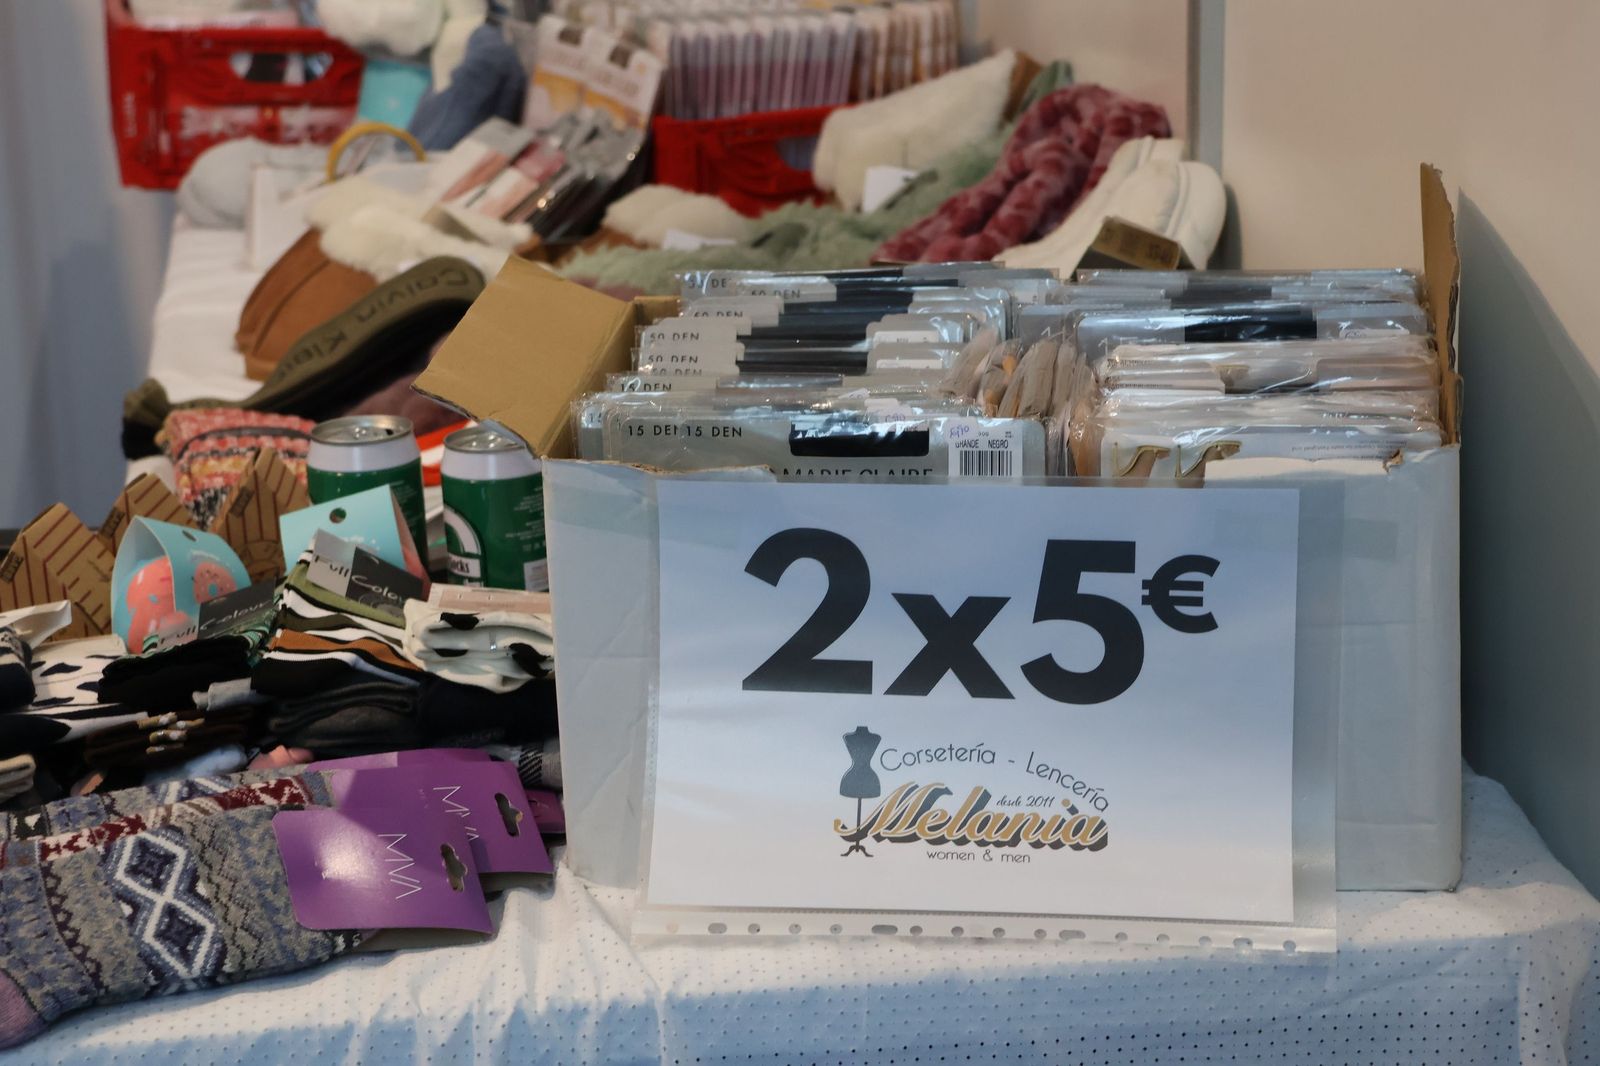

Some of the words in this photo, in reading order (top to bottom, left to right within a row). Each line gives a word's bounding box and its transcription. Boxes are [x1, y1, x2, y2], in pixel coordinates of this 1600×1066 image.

[355, 265, 470, 323] Calvin
[627, 424, 645, 437] 15
[686, 425, 704, 438] 15
[711, 425, 743, 438] DEN
[879, 742, 996, 772] Corsetería
[1025, 750, 1110, 813] Lencería
[995, 794, 1023, 808] desde
[1025, 794, 1056, 808] 2011
[832, 780, 1110, 853] Melania
[926, 850, 976, 862] women
[982, 848, 994, 863] &
[1001, 852, 1031, 864] men
